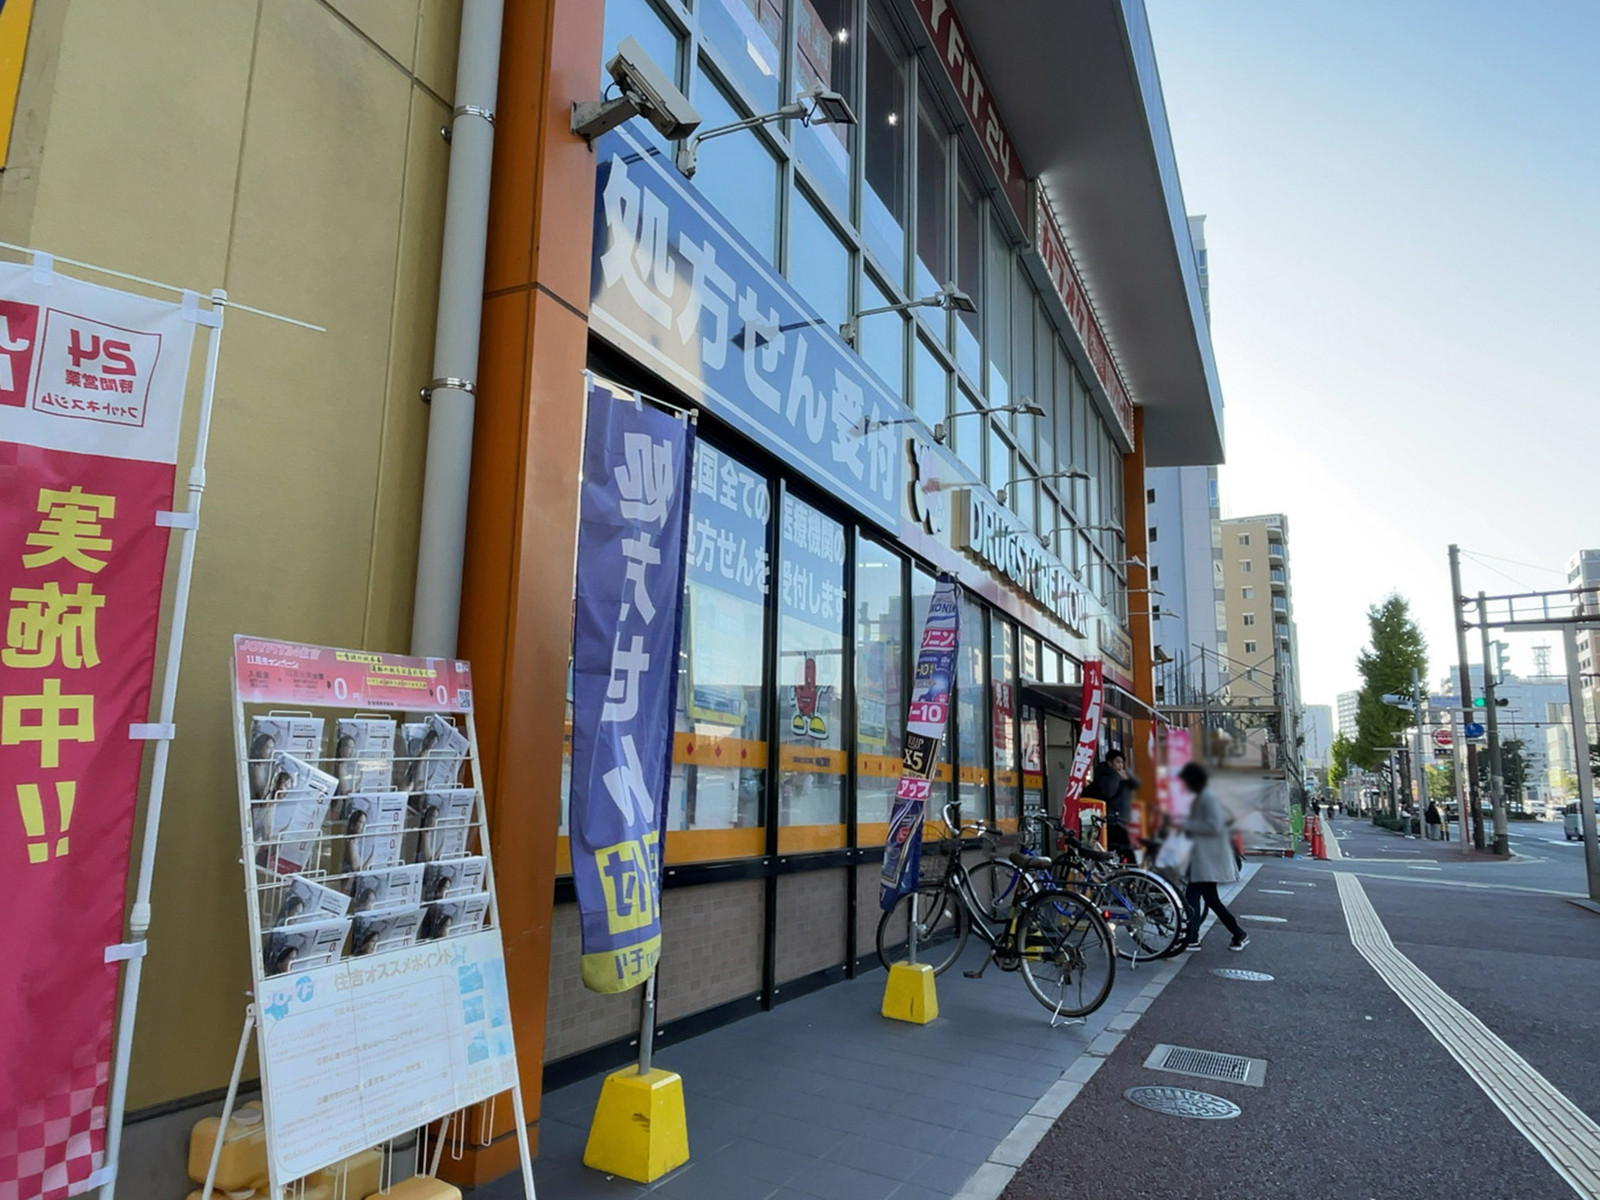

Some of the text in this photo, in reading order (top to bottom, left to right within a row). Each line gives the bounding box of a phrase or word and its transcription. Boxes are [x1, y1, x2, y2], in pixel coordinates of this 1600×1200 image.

[600, 152, 898, 503] 処方せん受付
[691, 443, 771, 526] 国全ての
[783, 495, 846, 567] 医療機関の
[333, 947, 452, 993] 住吉オススメポイント
